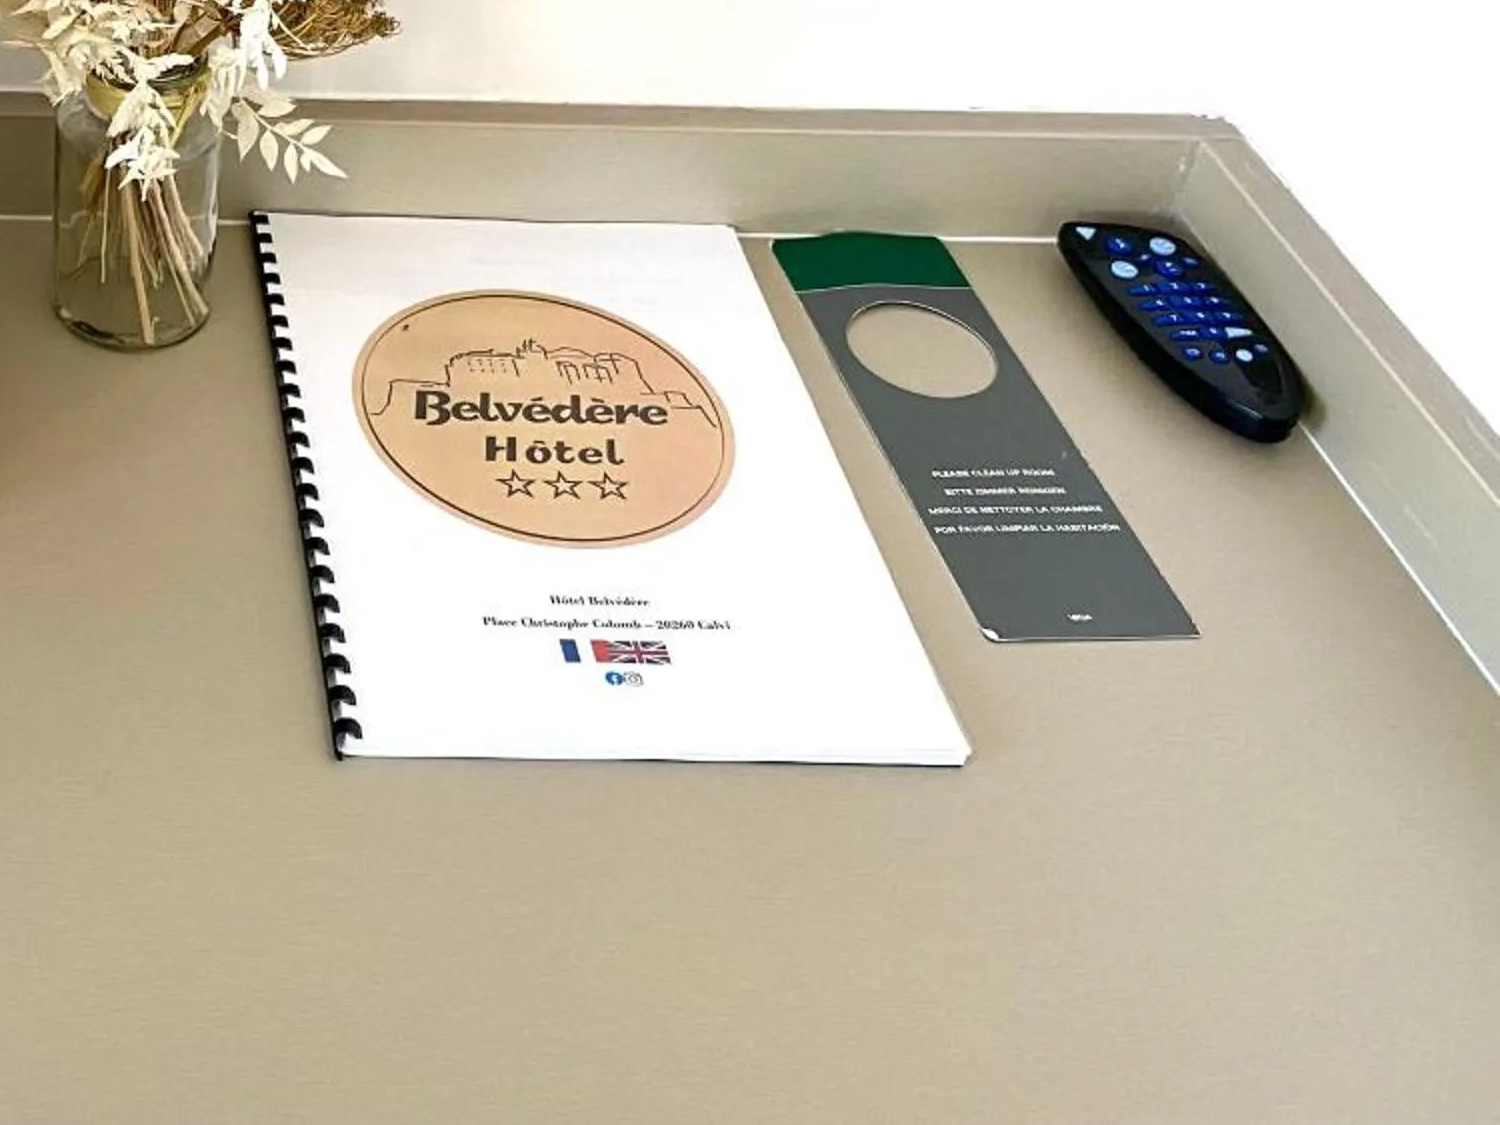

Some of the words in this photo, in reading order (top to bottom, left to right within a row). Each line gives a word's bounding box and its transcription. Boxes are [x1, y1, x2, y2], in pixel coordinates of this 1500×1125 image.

[415, 390, 668, 426] Belvédère
[485, 436, 625, 465] Hôtel
[482, 615, 518, 627] Place
[520, 616, 589, 631] Christophe
